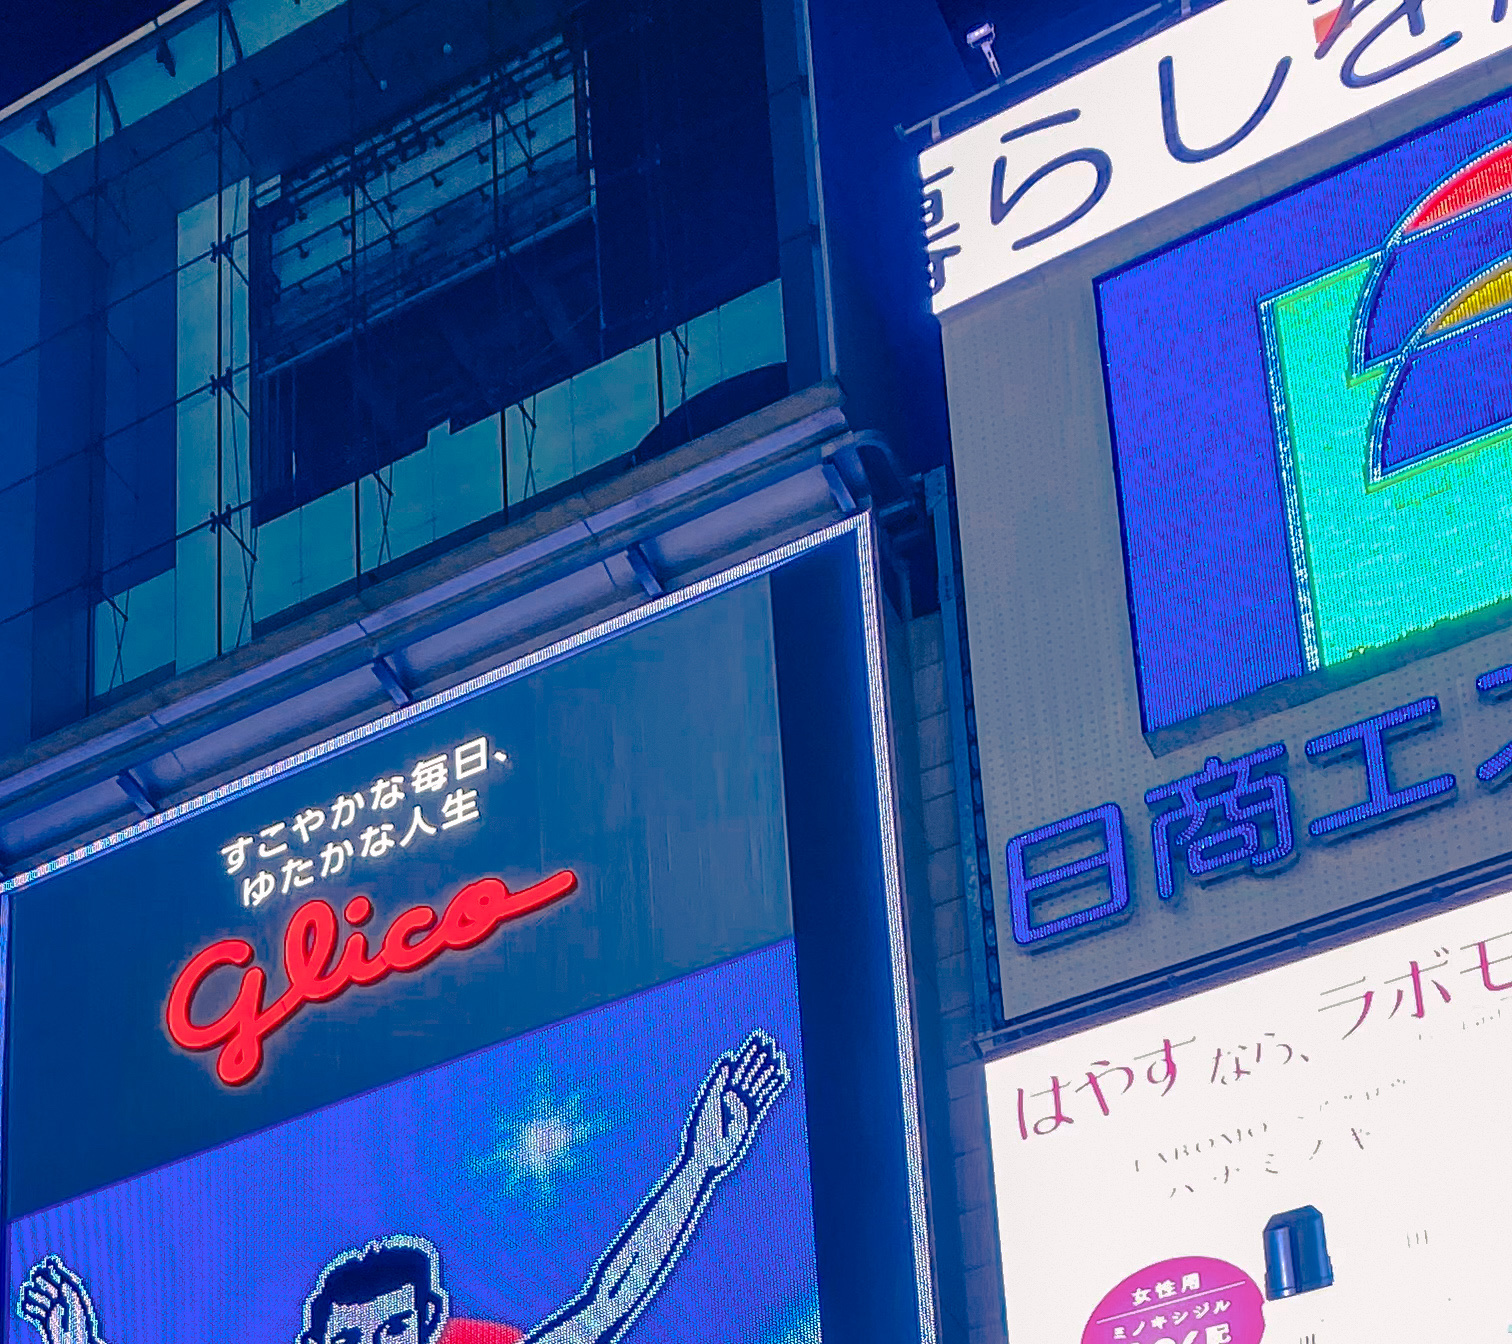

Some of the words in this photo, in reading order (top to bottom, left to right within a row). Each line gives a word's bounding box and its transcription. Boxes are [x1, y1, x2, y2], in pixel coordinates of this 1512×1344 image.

[220, 736, 508, 876] すこやかな毎日、
[243, 788, 481, 907] ゆたかな人生
[1113, 1298, 1231, 1340] ミノキシジル
[1131, 1272, 1202, 1307] 女性用
